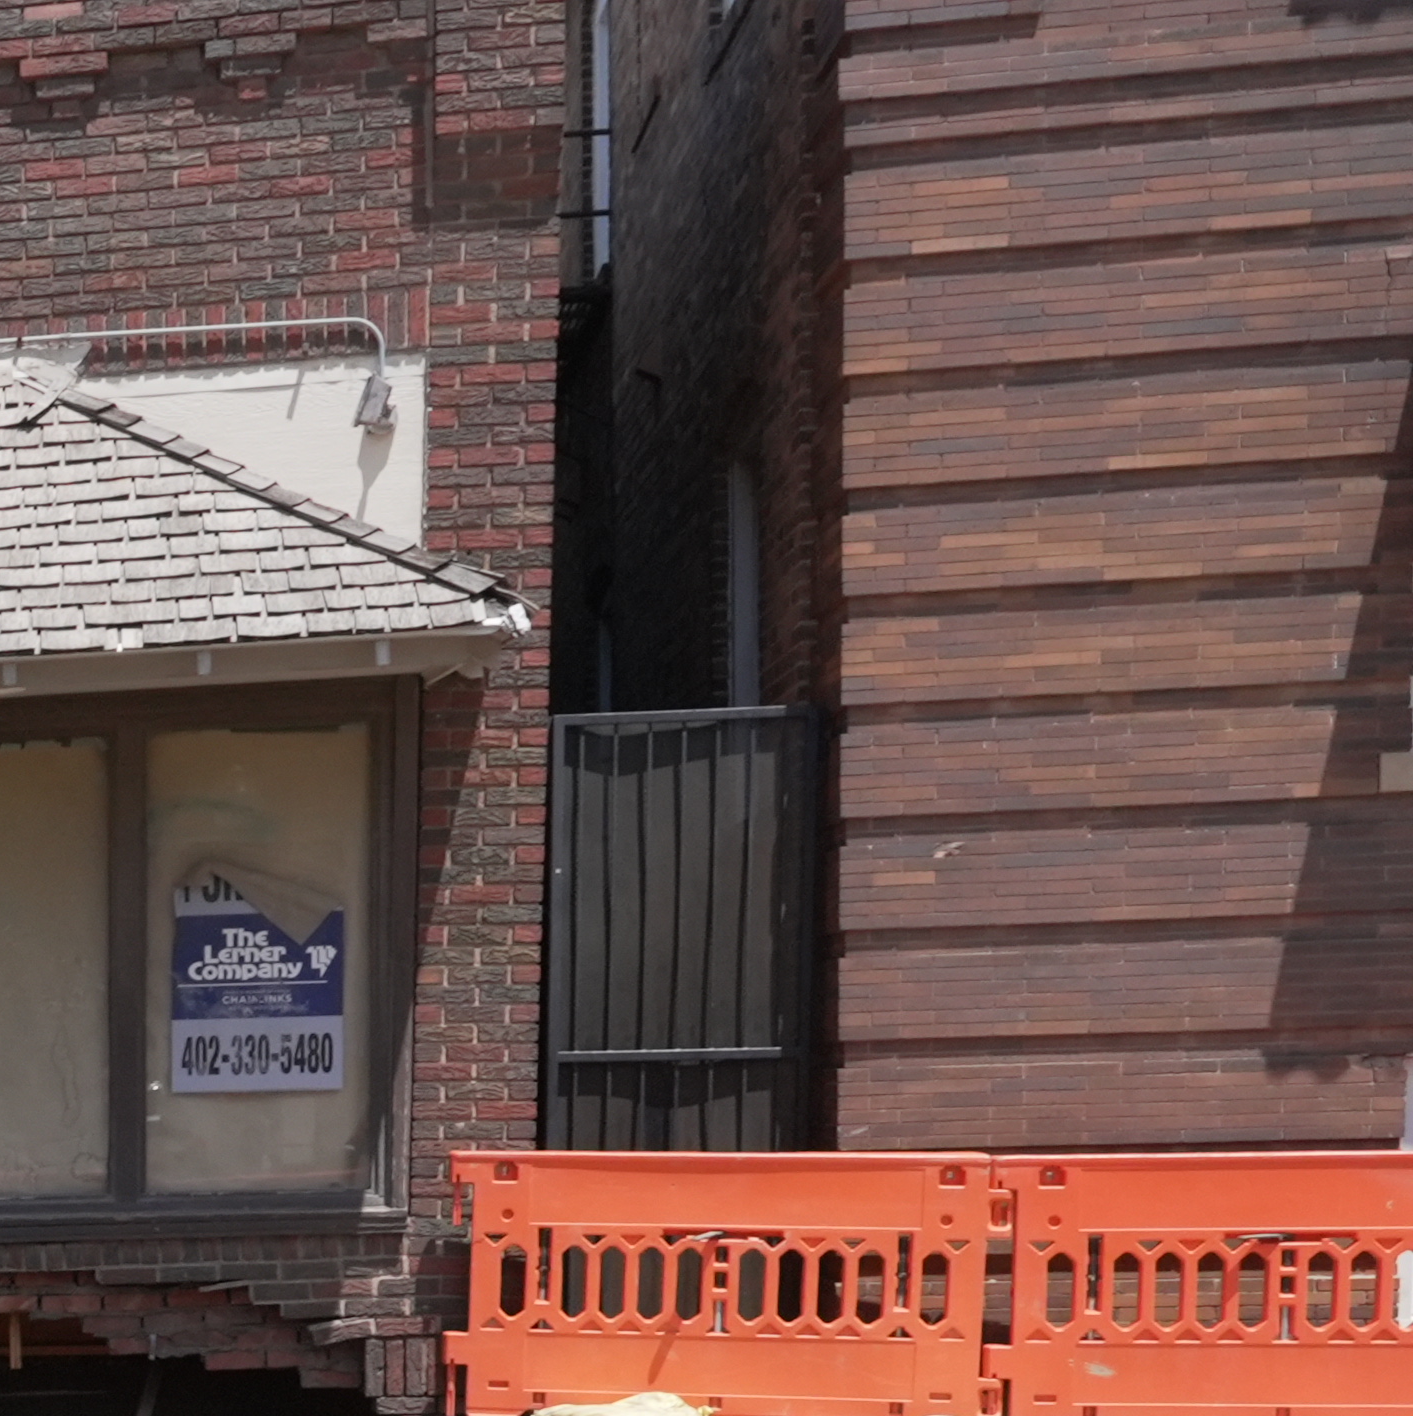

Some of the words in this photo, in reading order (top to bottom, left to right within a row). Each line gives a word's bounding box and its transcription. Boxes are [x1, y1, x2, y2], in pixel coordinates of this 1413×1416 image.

[222, 927, 269, 947] The
[203, 945, 287, 965] Lerner
[187, 961, 303, 981] Company
[181, 1032, 333, 1076] 402-330-5480
